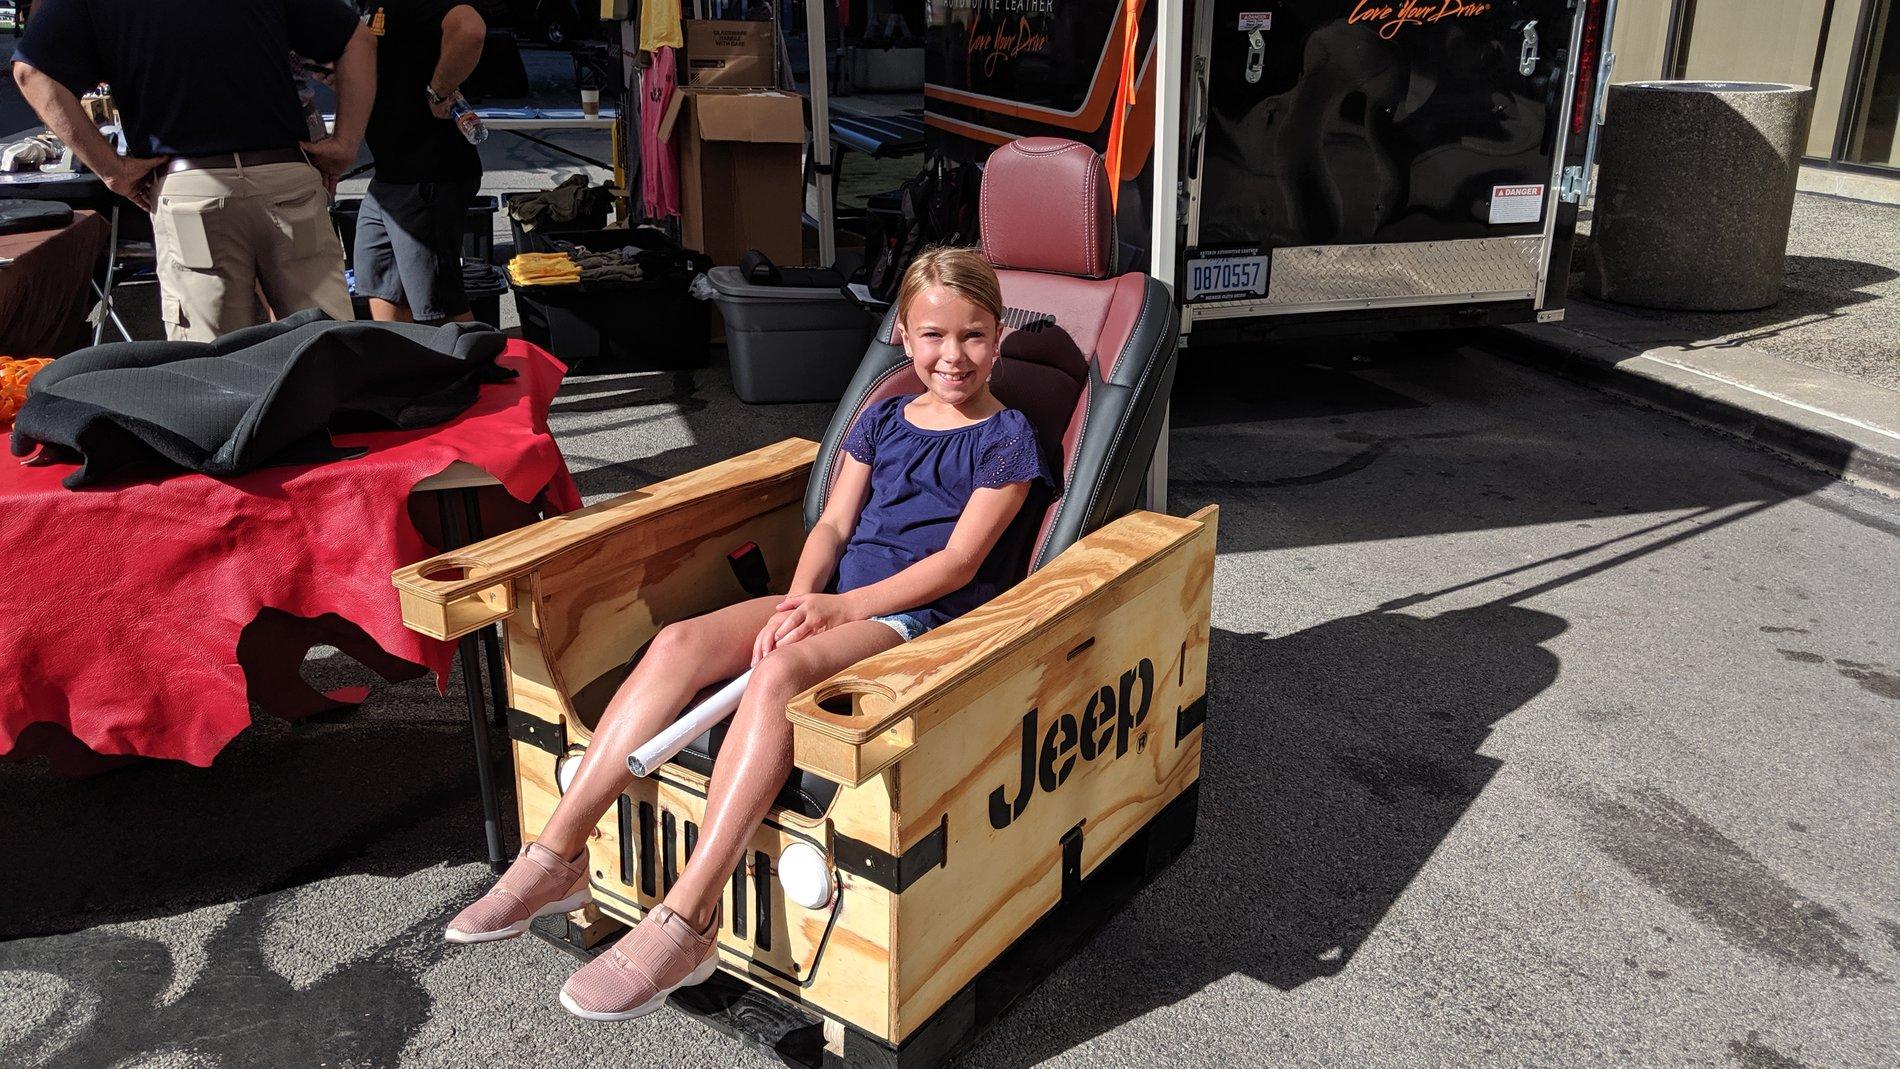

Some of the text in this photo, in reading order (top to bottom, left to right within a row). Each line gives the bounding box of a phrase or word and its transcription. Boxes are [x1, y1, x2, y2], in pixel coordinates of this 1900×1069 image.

[1005, 0, 1054, 13] LEATHER
[1348, 0, 1392, 25] Love
[1379, 0, 1436, 40] Your
[968, 14, 991, 55] Love
[984, 17, 1015, 77] Your
[1505, 188, 1537, 196] DANGER
[1194, 263, 1260, 291] D870557
[989, 657, 1155, 830] Jeep
